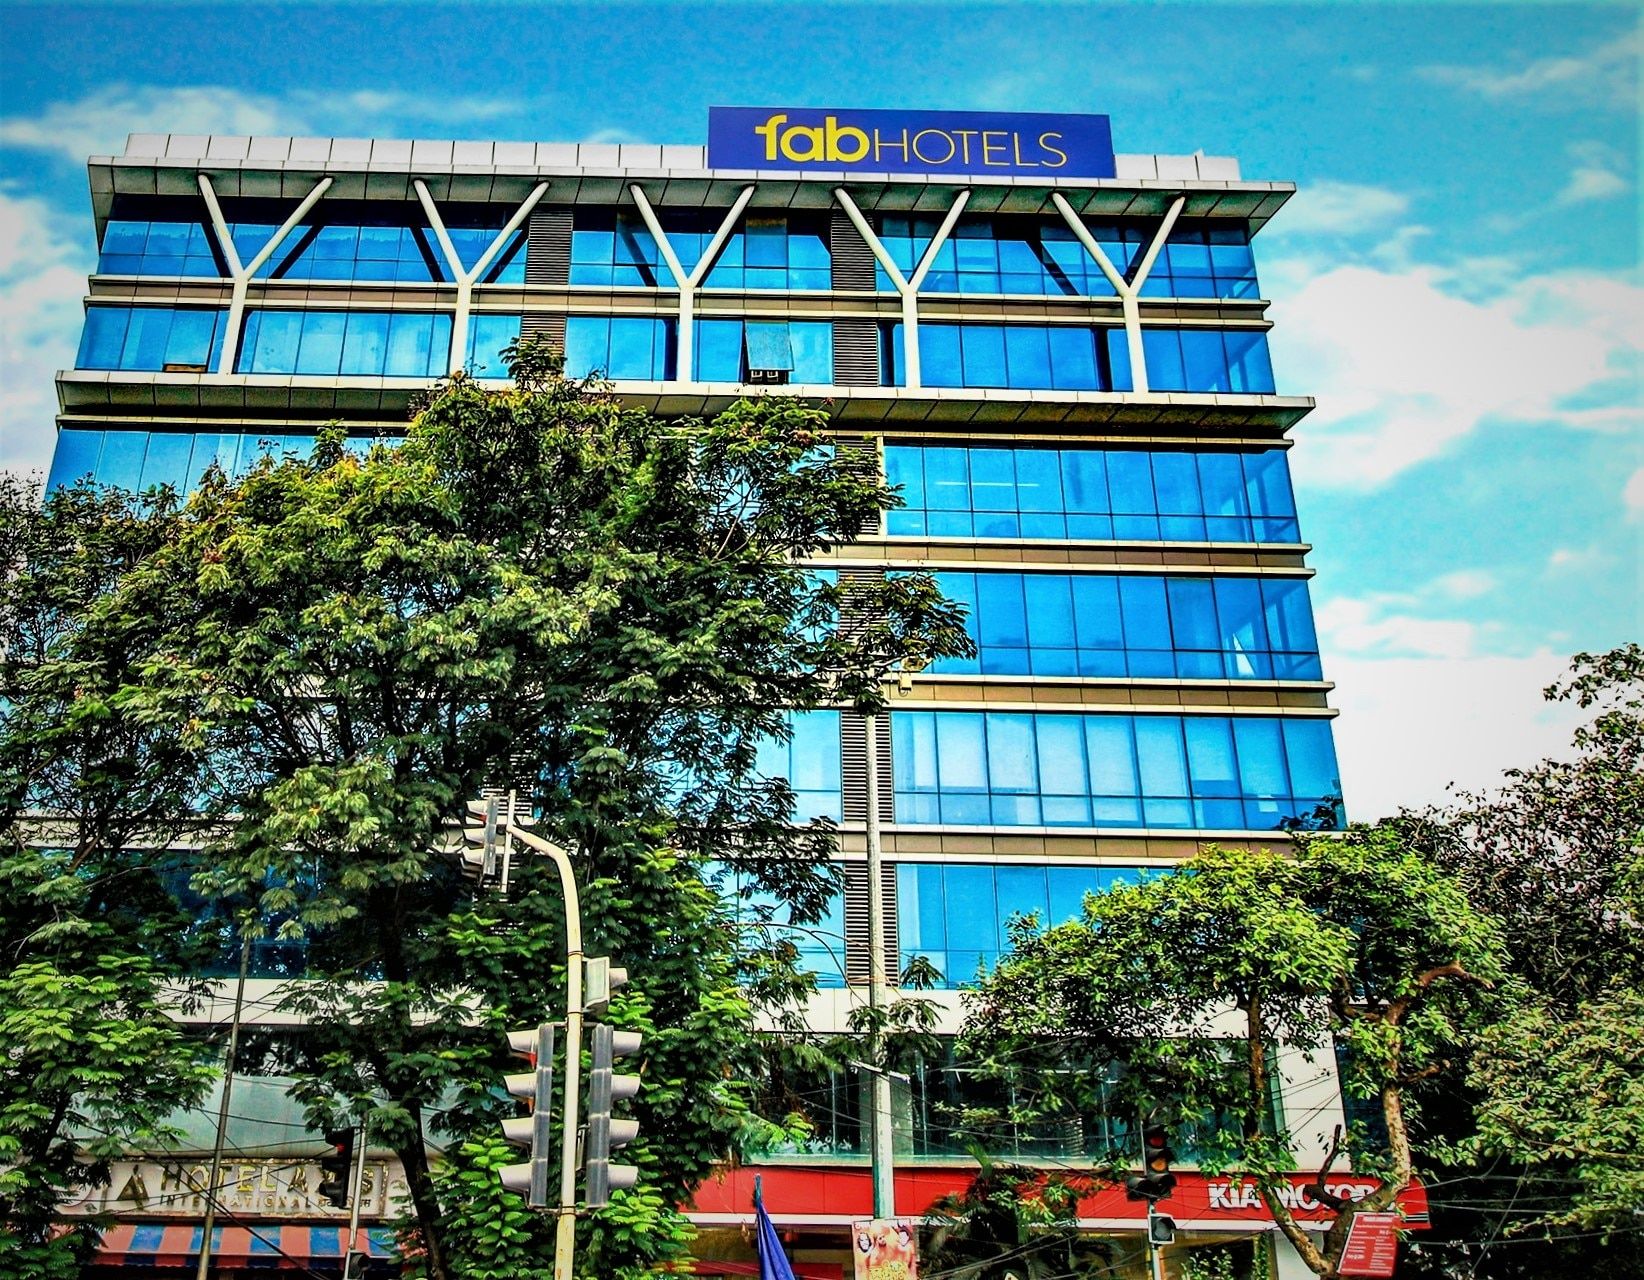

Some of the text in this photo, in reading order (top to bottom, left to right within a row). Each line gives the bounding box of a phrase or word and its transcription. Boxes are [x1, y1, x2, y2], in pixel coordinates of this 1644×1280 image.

[160, 1164, 278, 1192] HOTEL
[160, 1194, 311, 1208] INTENATIONAL
[1207, 1183, 1262, 1209] KIA
